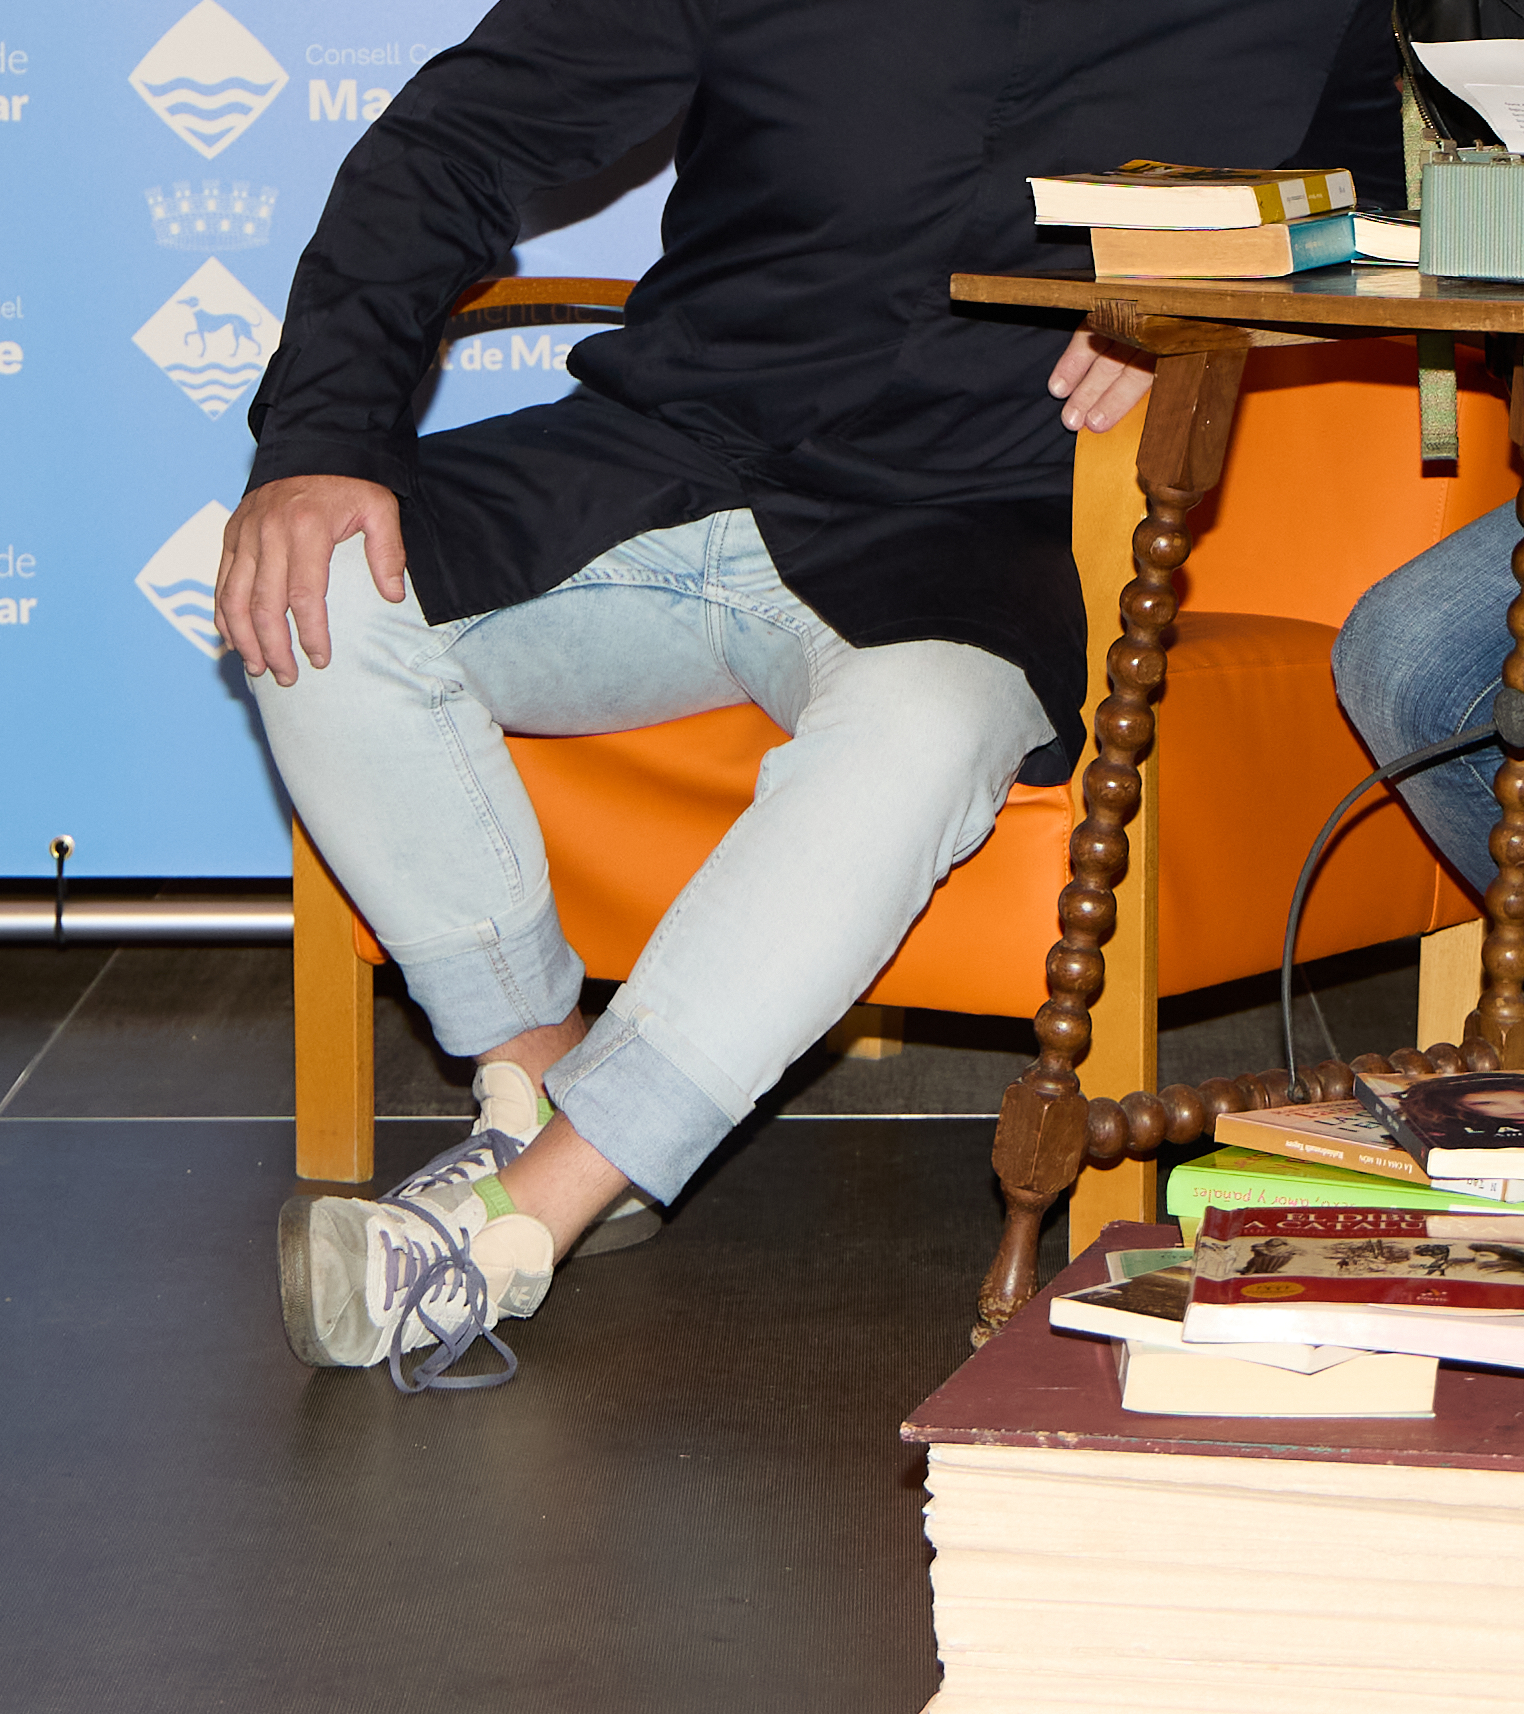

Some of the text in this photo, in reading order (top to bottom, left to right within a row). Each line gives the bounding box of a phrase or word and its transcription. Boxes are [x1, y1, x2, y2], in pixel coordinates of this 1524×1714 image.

[306, 43, 401, 65] Consell
[461, 334, 575, 371] de Ma
[1192, 1186, 1254, 1204] pañales
[1244, 1220, 1266, 1229] A
[1287, 1212, 1325, 1222] EL
